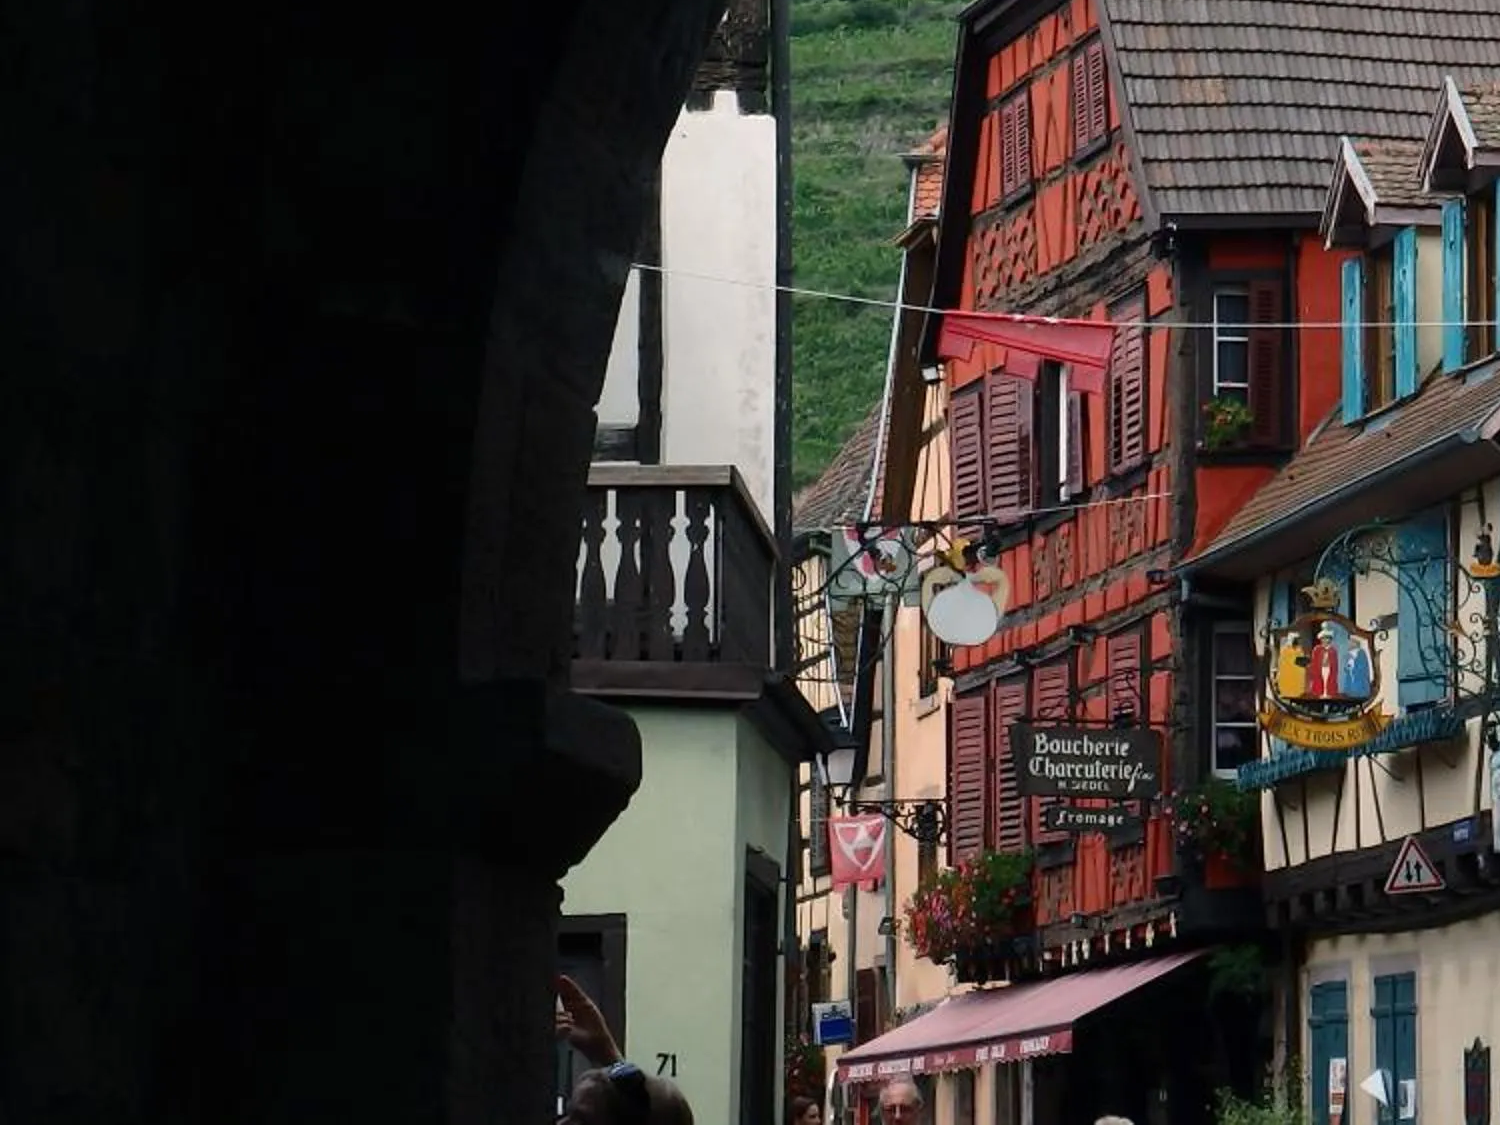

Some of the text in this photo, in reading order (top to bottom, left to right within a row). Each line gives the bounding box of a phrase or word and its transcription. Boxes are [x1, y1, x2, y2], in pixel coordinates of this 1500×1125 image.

[1034, 732, 1131, 757] Boucherie
[1028, 756, 1133, 781] Charcuterie
[656, 1052, 677, 1078] 71
